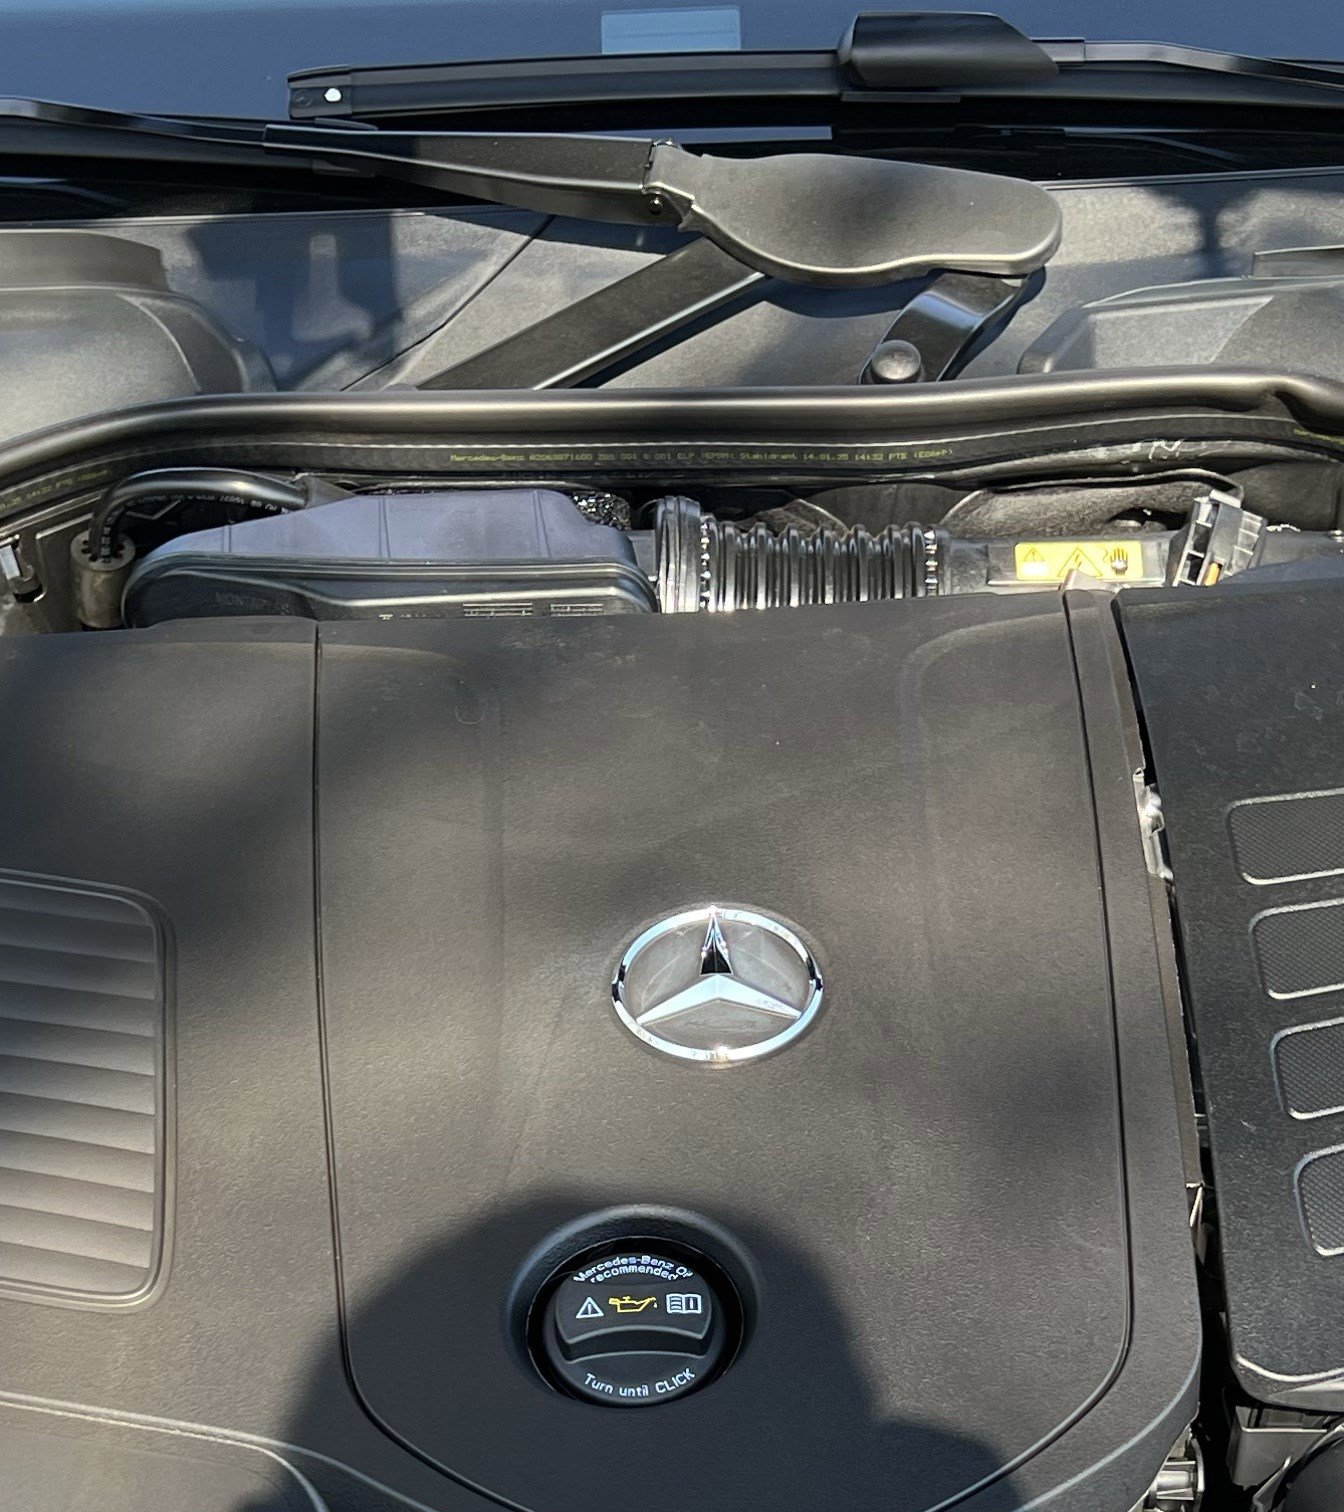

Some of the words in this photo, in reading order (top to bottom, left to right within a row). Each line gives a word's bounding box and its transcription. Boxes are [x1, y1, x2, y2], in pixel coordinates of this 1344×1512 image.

[573, 1255, 675, 1282] Mercedes-Benz
[675, 1265, 694, 1278] Oil
[590, 1264, 678, 1283] recommended
[584, 1372, 614, 1394] Turn
[619, 1384, 649, 1397] until
[655, 1367, 696, 1393] CLICK
